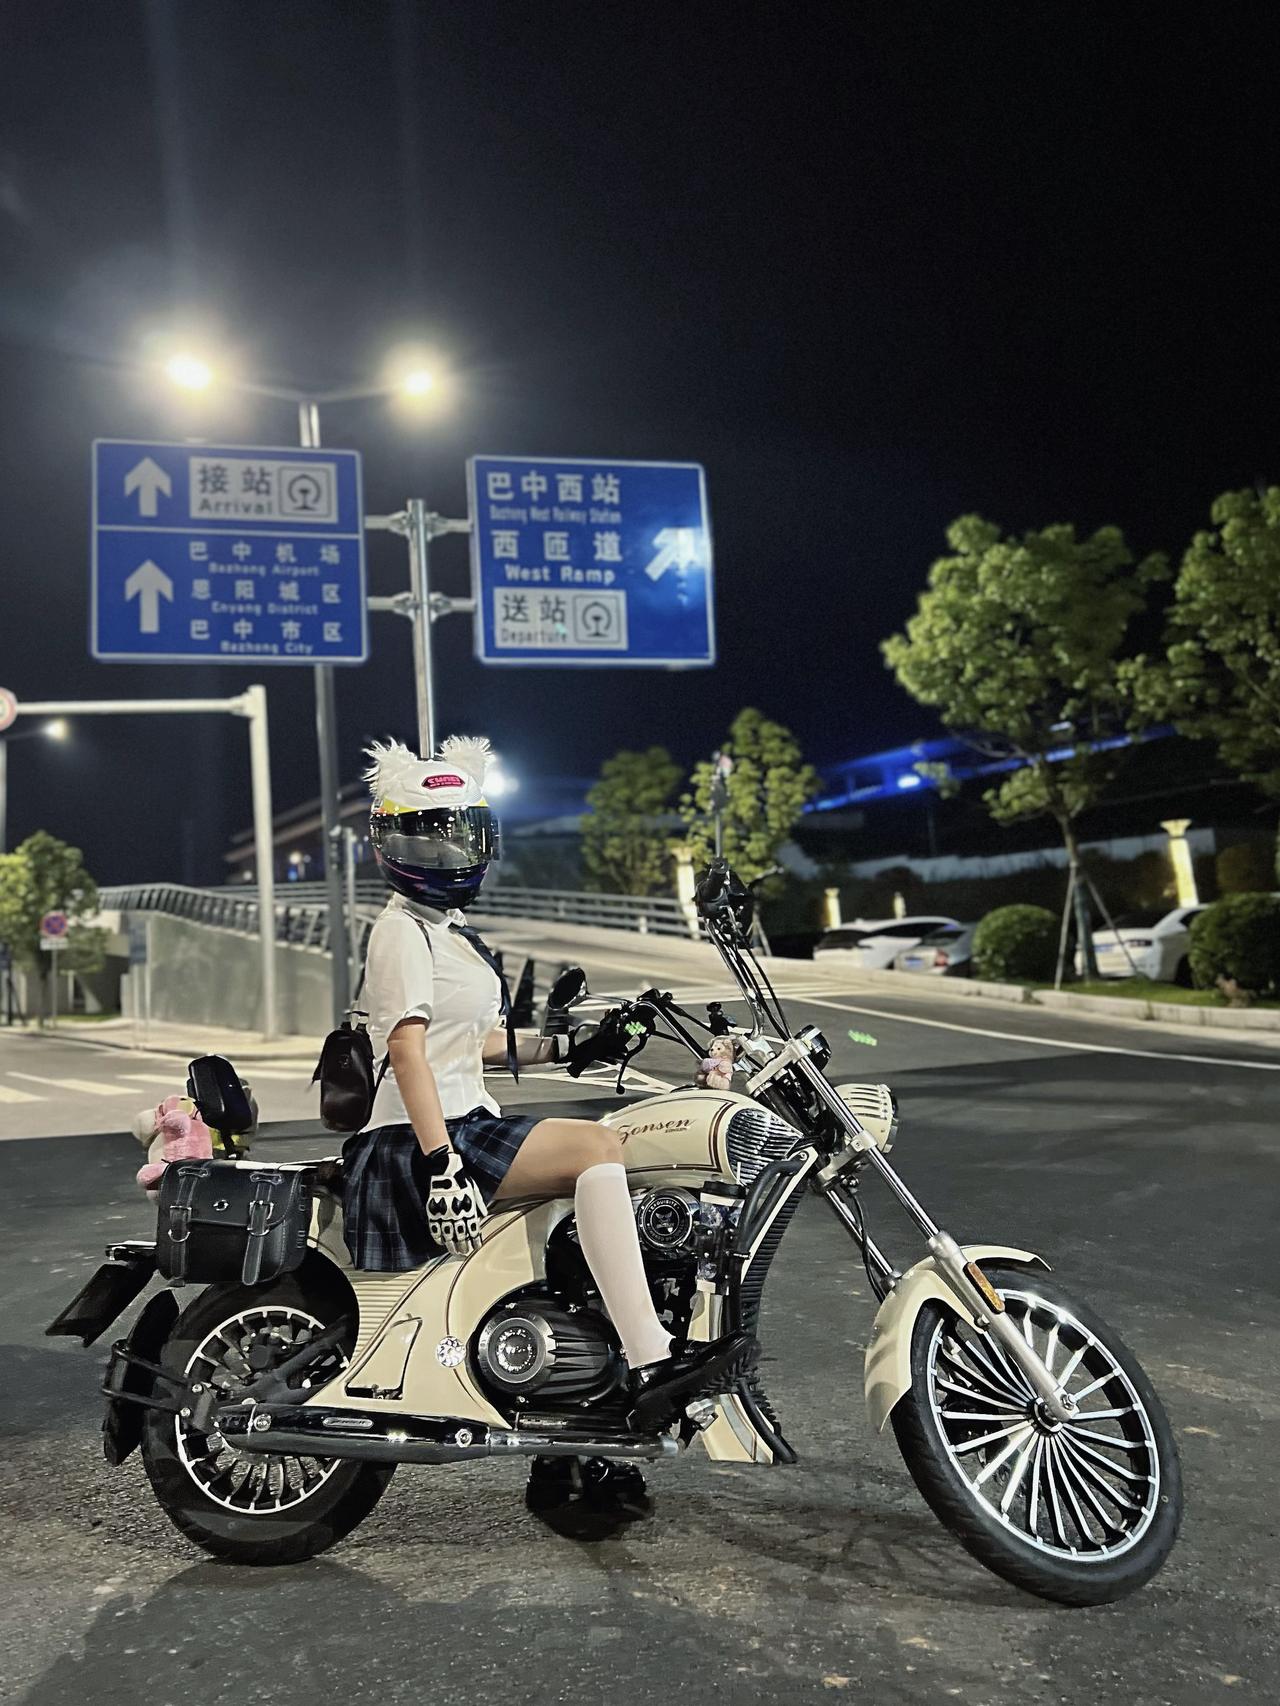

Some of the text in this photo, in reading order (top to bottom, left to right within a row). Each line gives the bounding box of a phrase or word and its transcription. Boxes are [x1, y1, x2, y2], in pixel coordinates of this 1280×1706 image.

[198, 465, 272, 495] 接站
[487, 470, 621, 505] 巴中西站
[199, 499, 273, 515] Arrival
[189, 540, 340, 565] 巴中机场
[504, 564, 616, 586] West Ramp
[501, 595, 567, 624] 送站
[190, 618, 343, 643] 巴中市区
